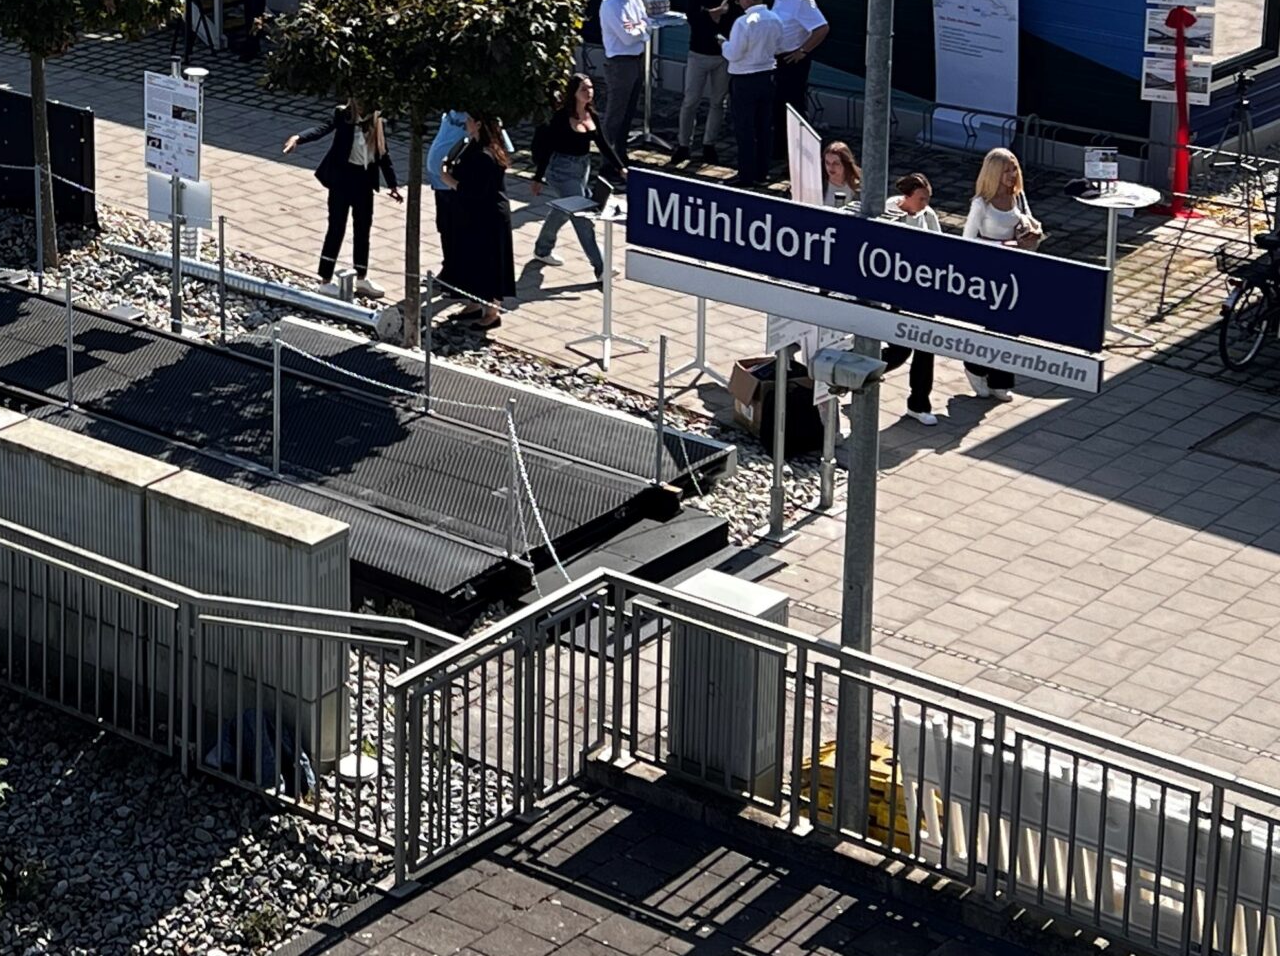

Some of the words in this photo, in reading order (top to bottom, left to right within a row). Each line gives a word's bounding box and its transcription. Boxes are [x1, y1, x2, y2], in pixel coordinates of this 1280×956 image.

[646, 187, 836, 265] Mühldorf
[858, 241, 1020, 311] (Oberbay)
[894, 321, 1088, 383] Südostbayernbahn
